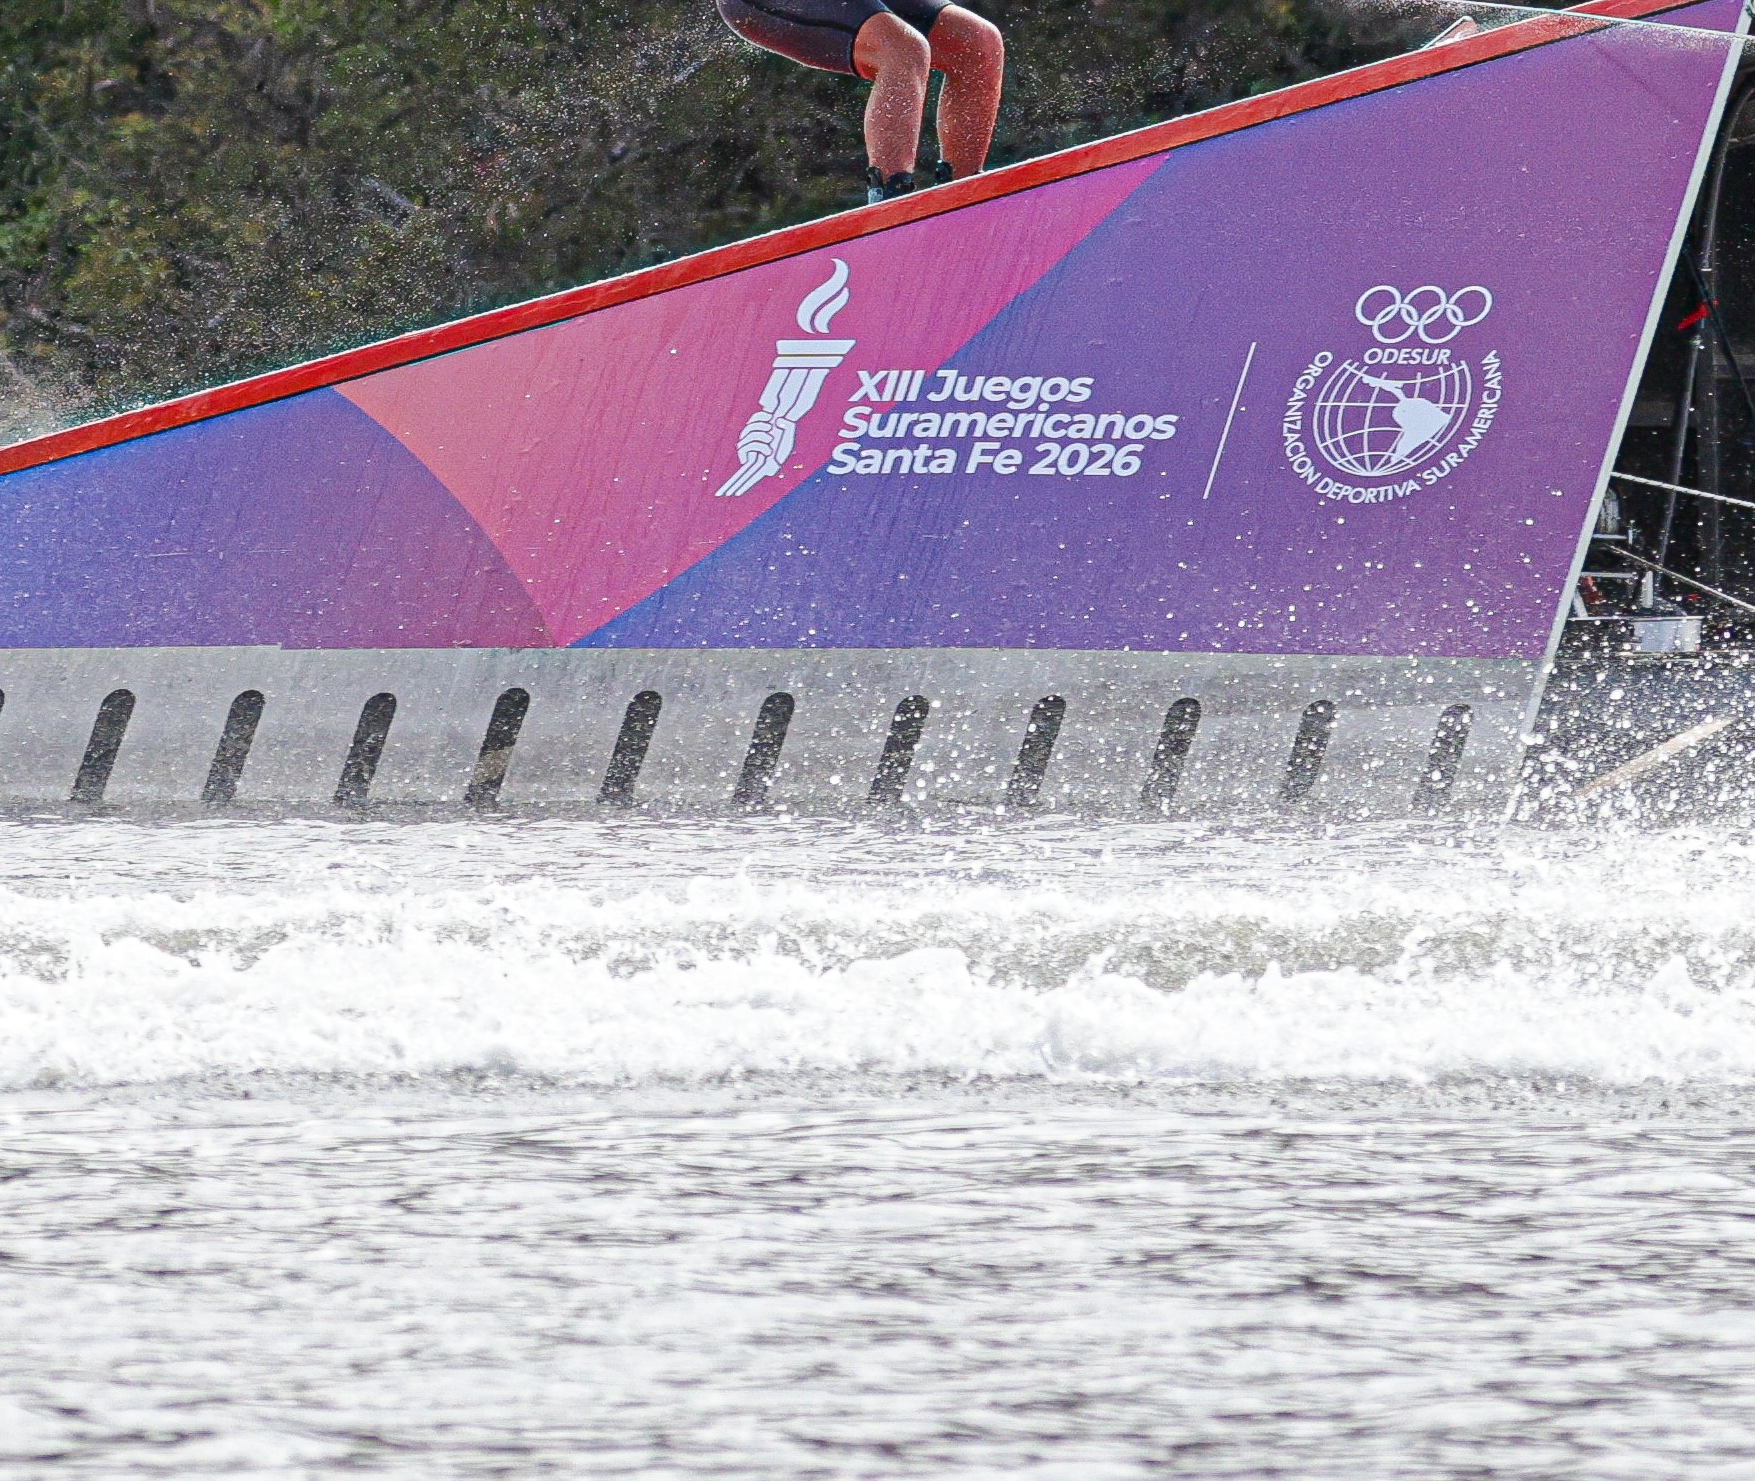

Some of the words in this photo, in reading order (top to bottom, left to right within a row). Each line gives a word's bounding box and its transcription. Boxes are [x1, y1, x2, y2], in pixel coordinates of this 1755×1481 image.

[1363, 347, 1452, 365] ODESUR
[847, 369, 925, 402] XIII
[926, 369, 1095, 410] Juegos
[838, 403, 1179, 441] Suramericanos
[1282, 350, 1334, 486] ORGANIZACION
[1314, 476, 1423, 504] DEPORTIVA
[1421, 349, 1503, 486] SURAMERICANA
[826, 441, 958, 475] Santa
[965, 441, 1023, 475] Fe
[1028, 442, 1145, 477] 2026
